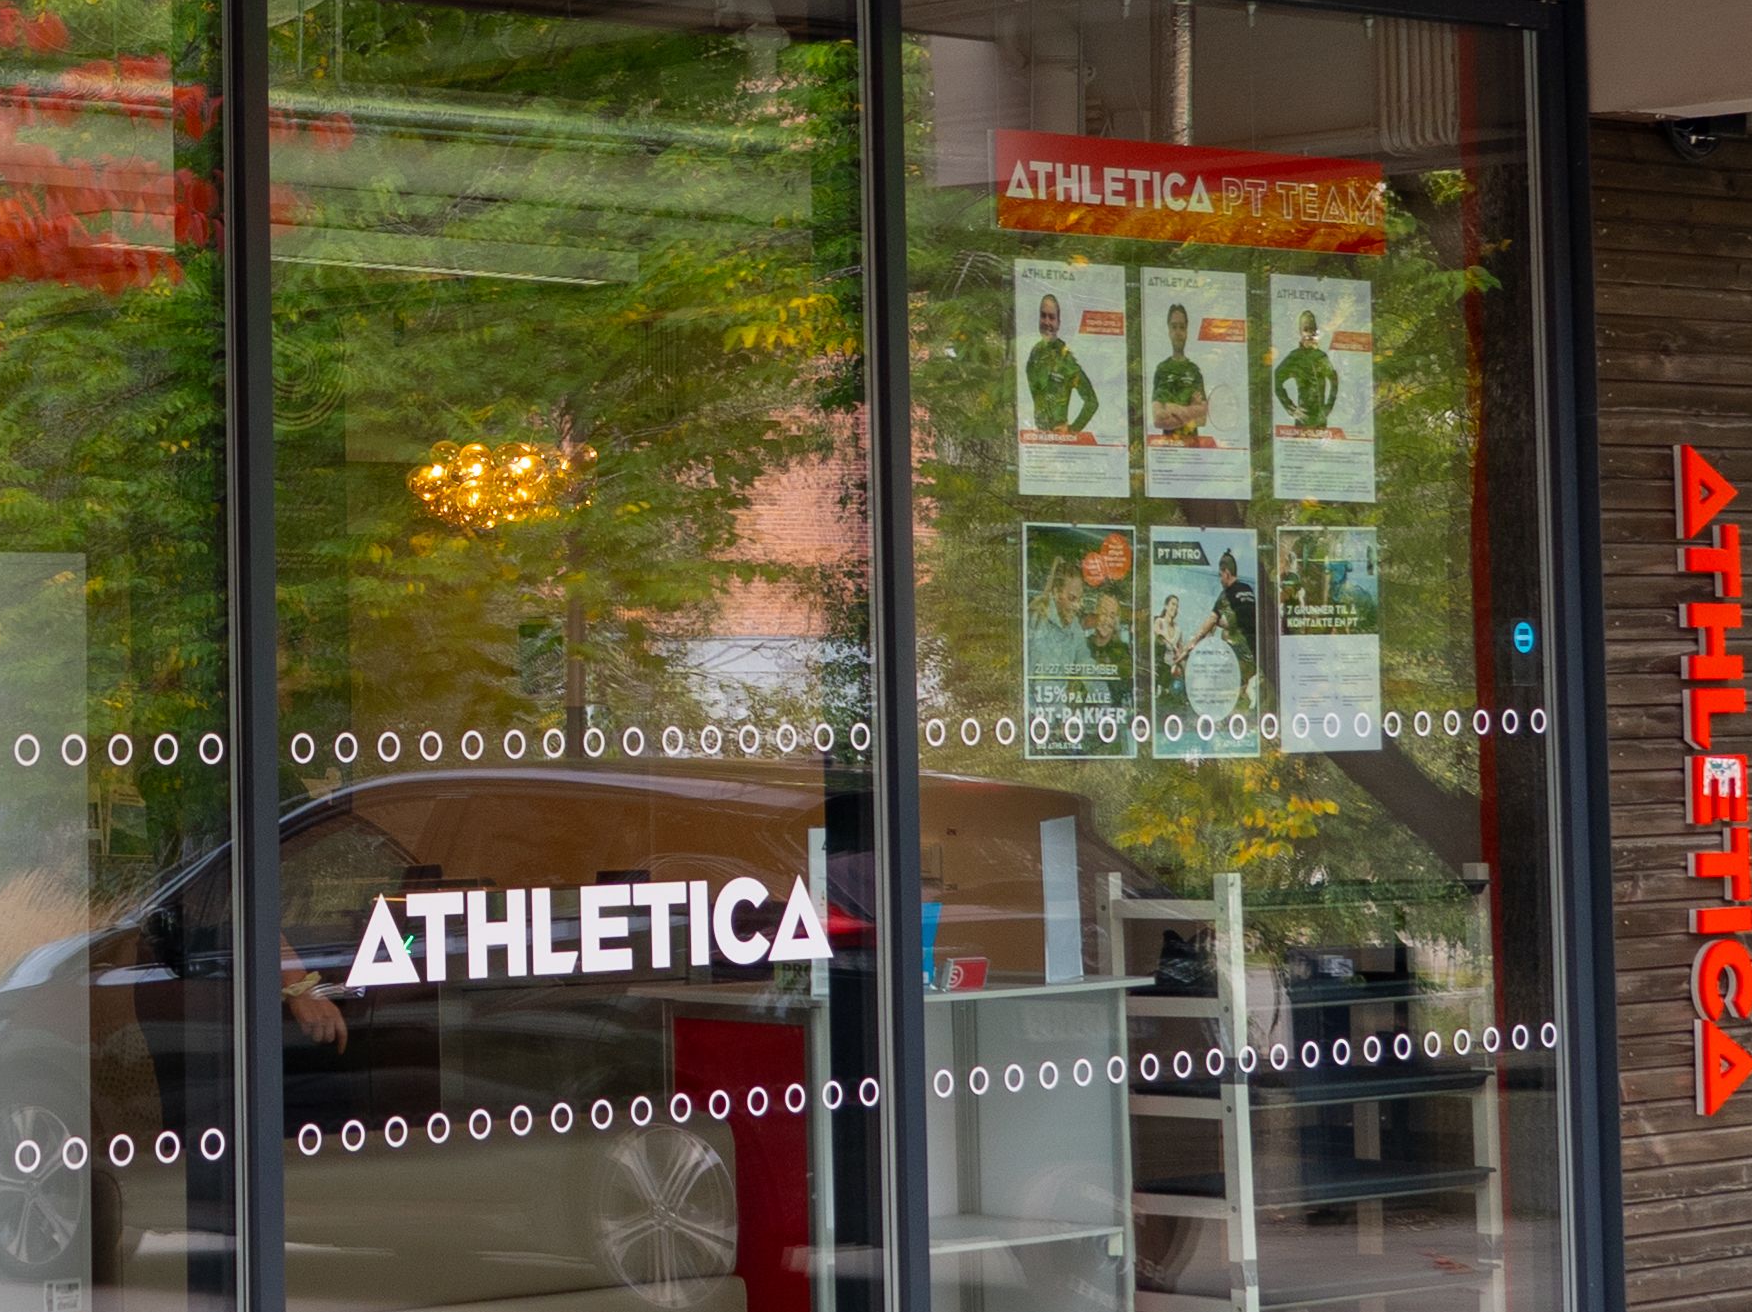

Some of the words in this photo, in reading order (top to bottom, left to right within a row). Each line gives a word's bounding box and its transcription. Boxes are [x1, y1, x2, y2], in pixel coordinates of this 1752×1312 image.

[1005, 159, 1214, 214] ATHLETICA
[1221, 177, 1268, 218] PT
[1276, 181, 1377, 226] TEAM
[1021, 268, 1076, 282] ATHLETICA
[1276, 289, 1326, 302] ATHLETICA
[1157, 548, 1171, 560] PT
[1172, 548, 1202, 560] INTRO
[1286, 605, 1293, 616] 7
[1294, 605, 1334, 616] GRUNNER
[1335, 605, 1348, 615] TIL
[1287, 617, 1333, 628] KONTAKTE
[1334, 617, 1346, 627] EN
[1347, 617, 1359, 627] PT
[1064, 663, 1118, 675] SEPTEMBER
[1034, 685, 1068, 704] 15%
[1068, 690, 1083, 704] PÅ
[1084, 691, 1112, 704] ALLE
[1034, 706, 1128, 724] PT-PAKKER
[345, 873, 834, 987] ATHLETICA
